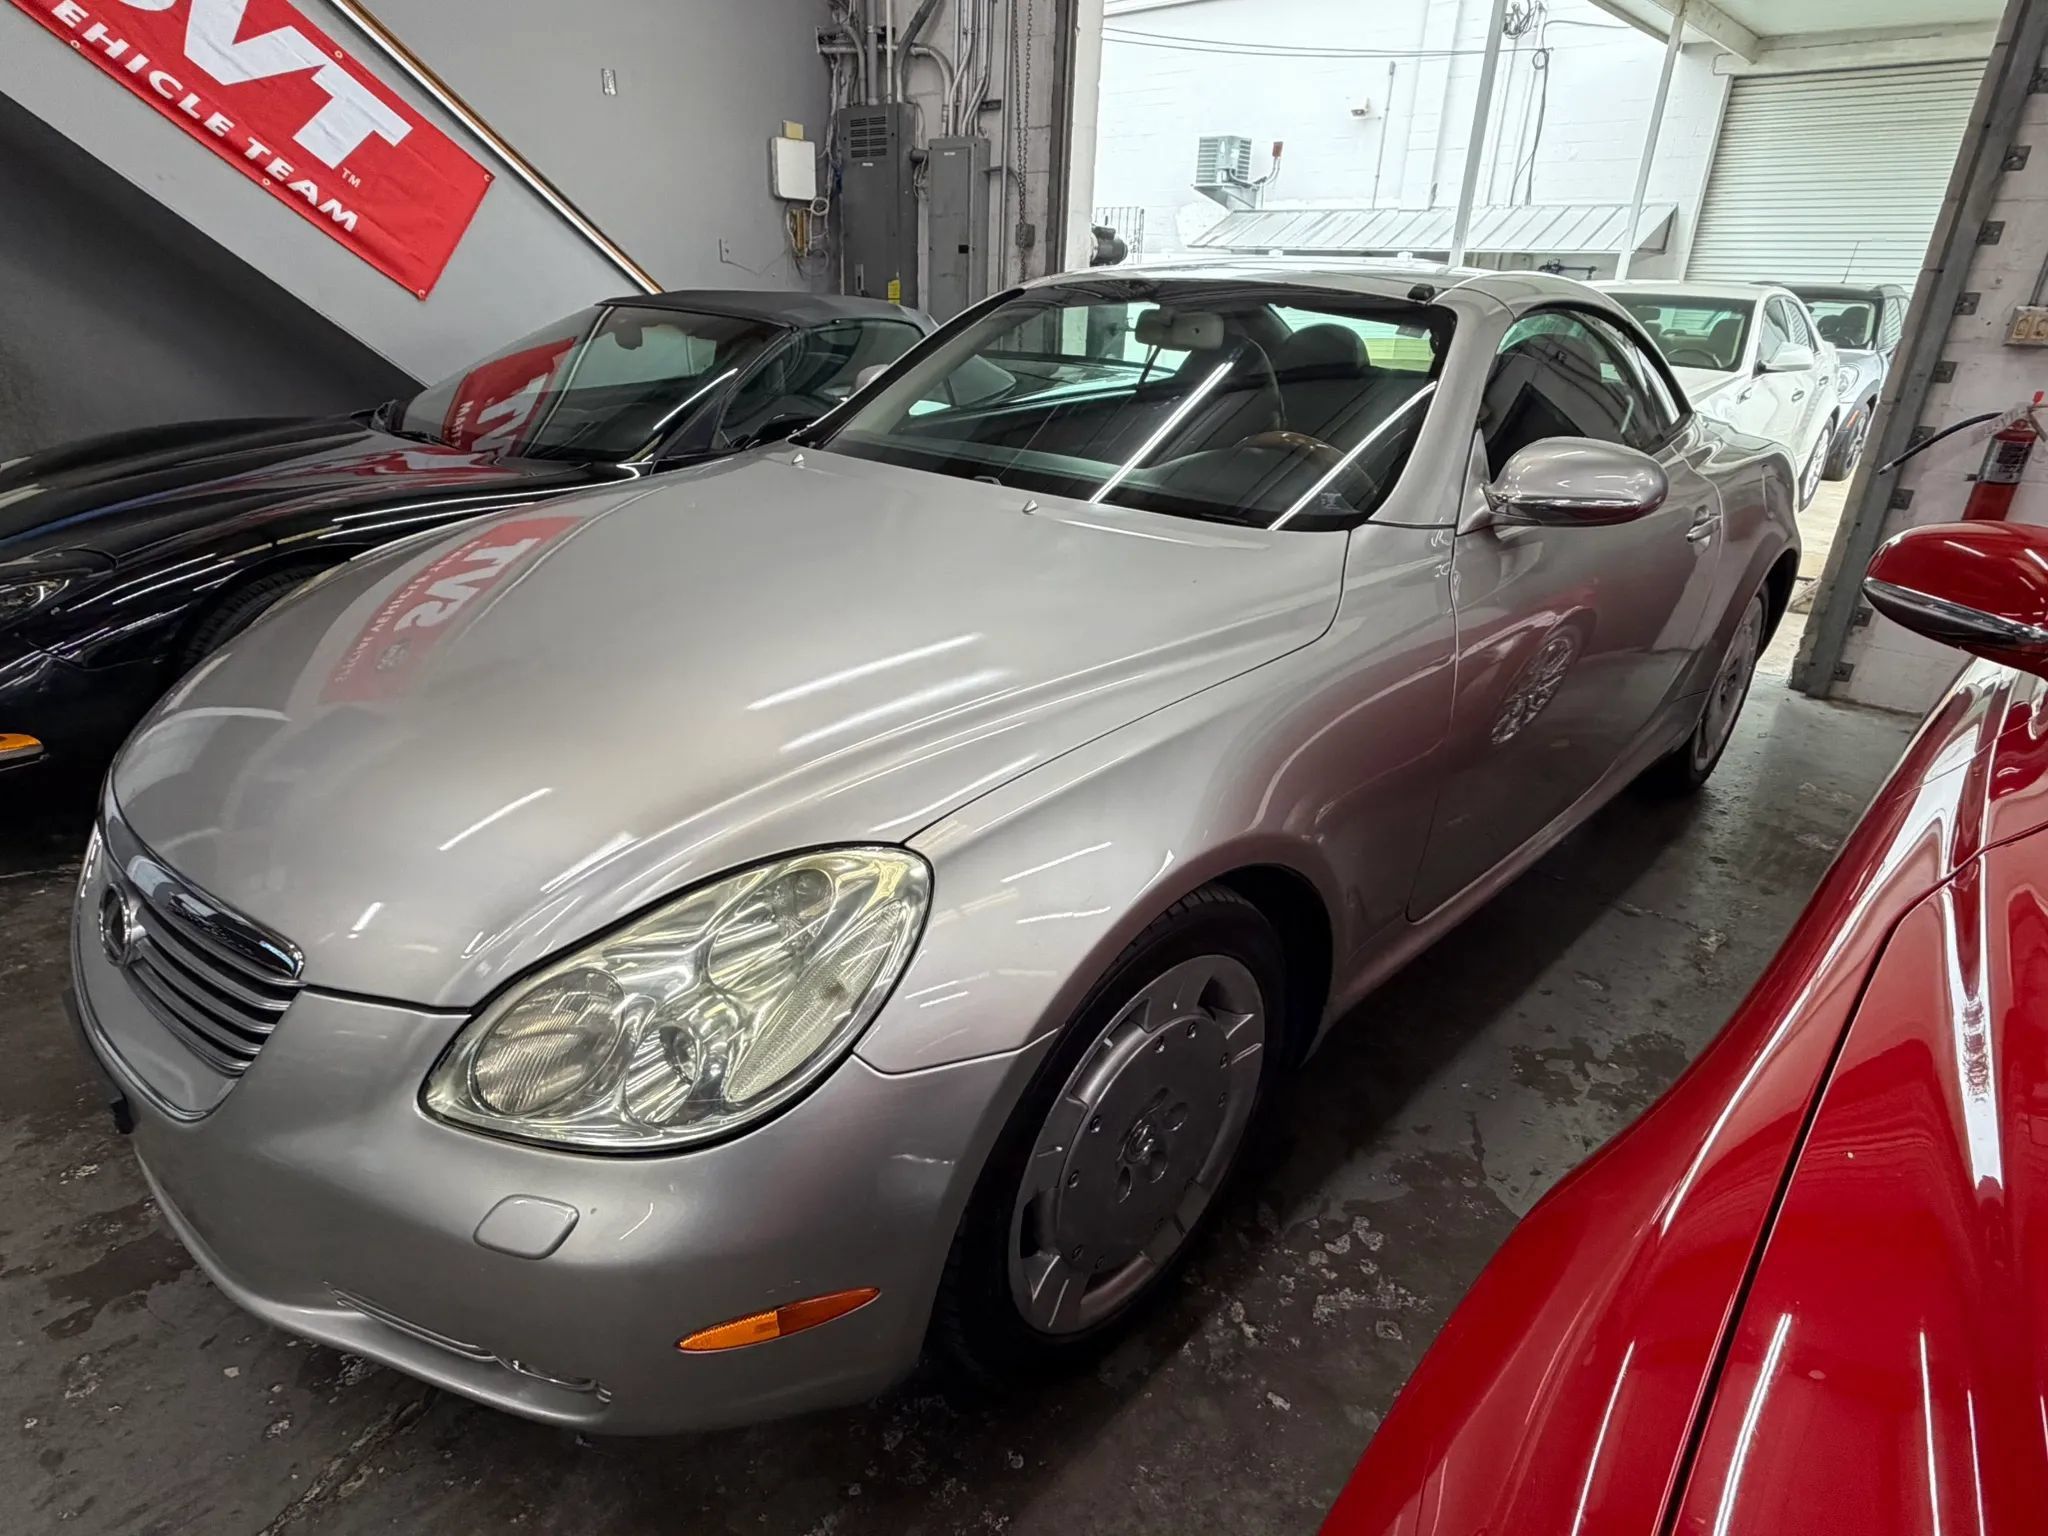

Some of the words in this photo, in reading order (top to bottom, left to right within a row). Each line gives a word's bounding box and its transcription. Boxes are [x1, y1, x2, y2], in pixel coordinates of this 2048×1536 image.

[115, 0, 414, 170] VT
[341, 167, 361, 188] TM
[242, 137, 358, 232] TEAM
